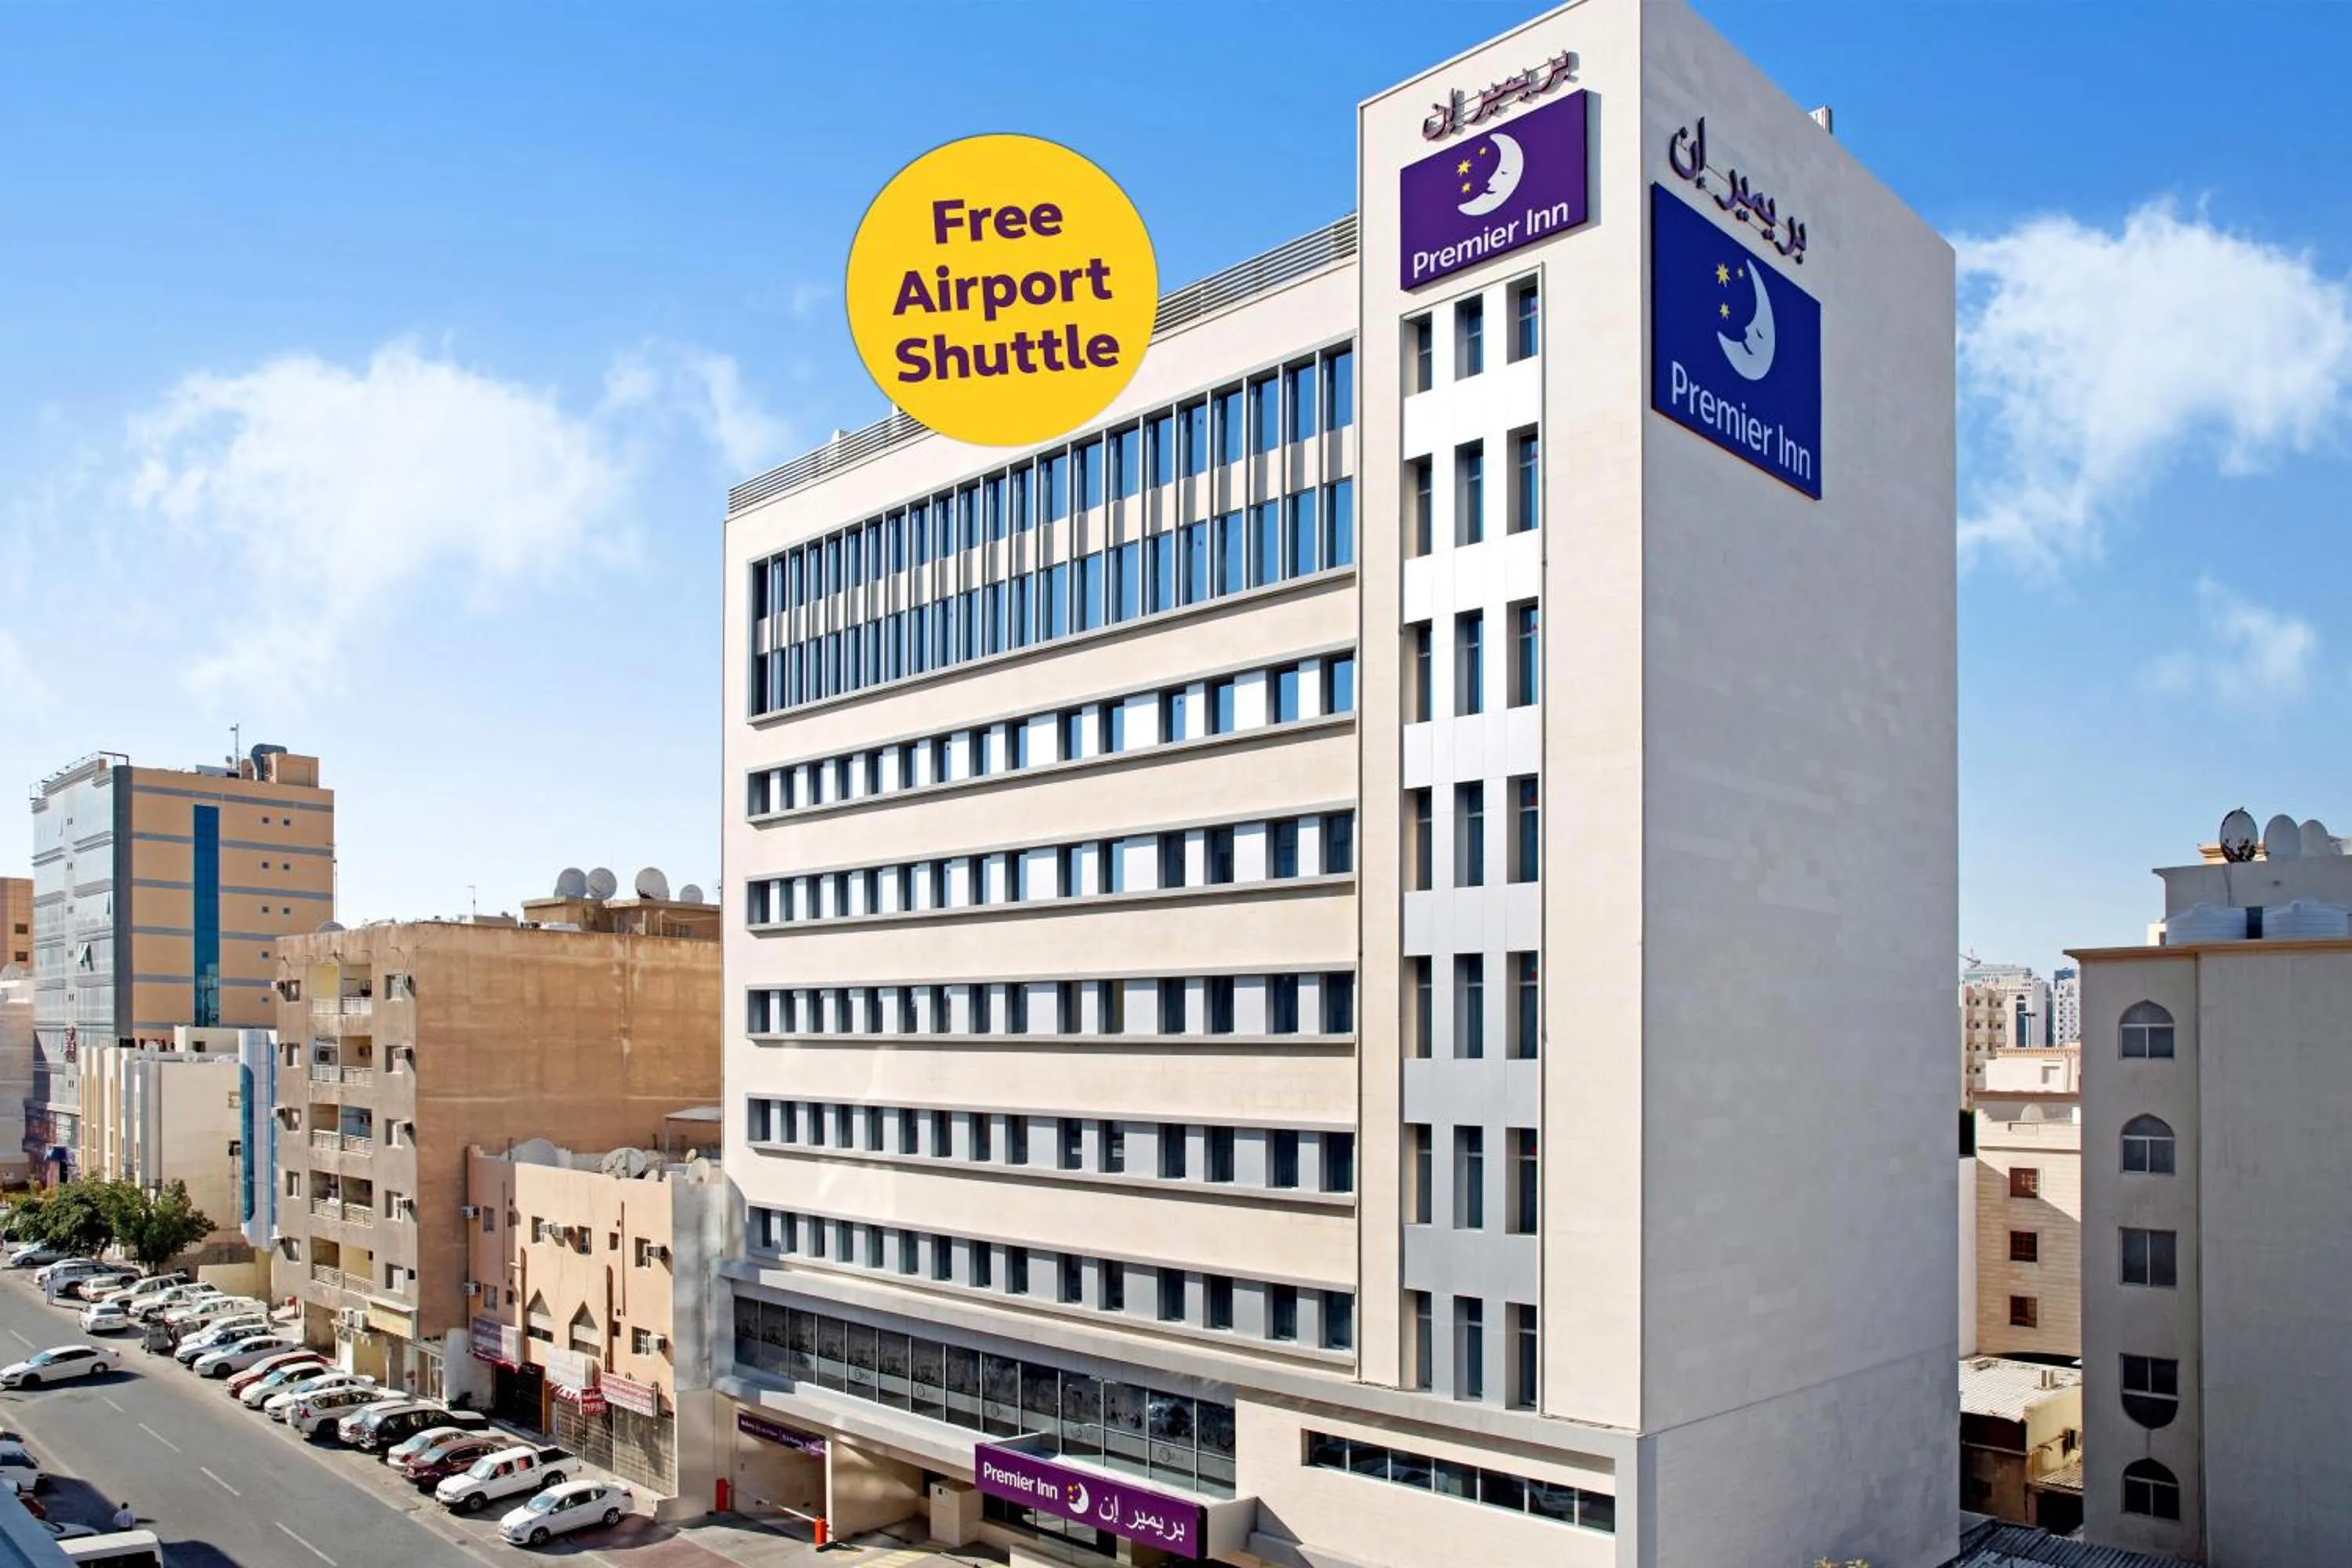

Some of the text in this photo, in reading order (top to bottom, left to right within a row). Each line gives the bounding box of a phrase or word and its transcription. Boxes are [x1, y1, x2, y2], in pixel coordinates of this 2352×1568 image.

[1669, 116, 1807, 265] بريمير إن
[1413, 201, 1569, 278] Premier Inn
[1671, 360, 1811, 481] Premier Inn
[983, 1461, 1058, 1501] Premier Inn
[1098, 1494, 1185, 1543] بريمير إن
